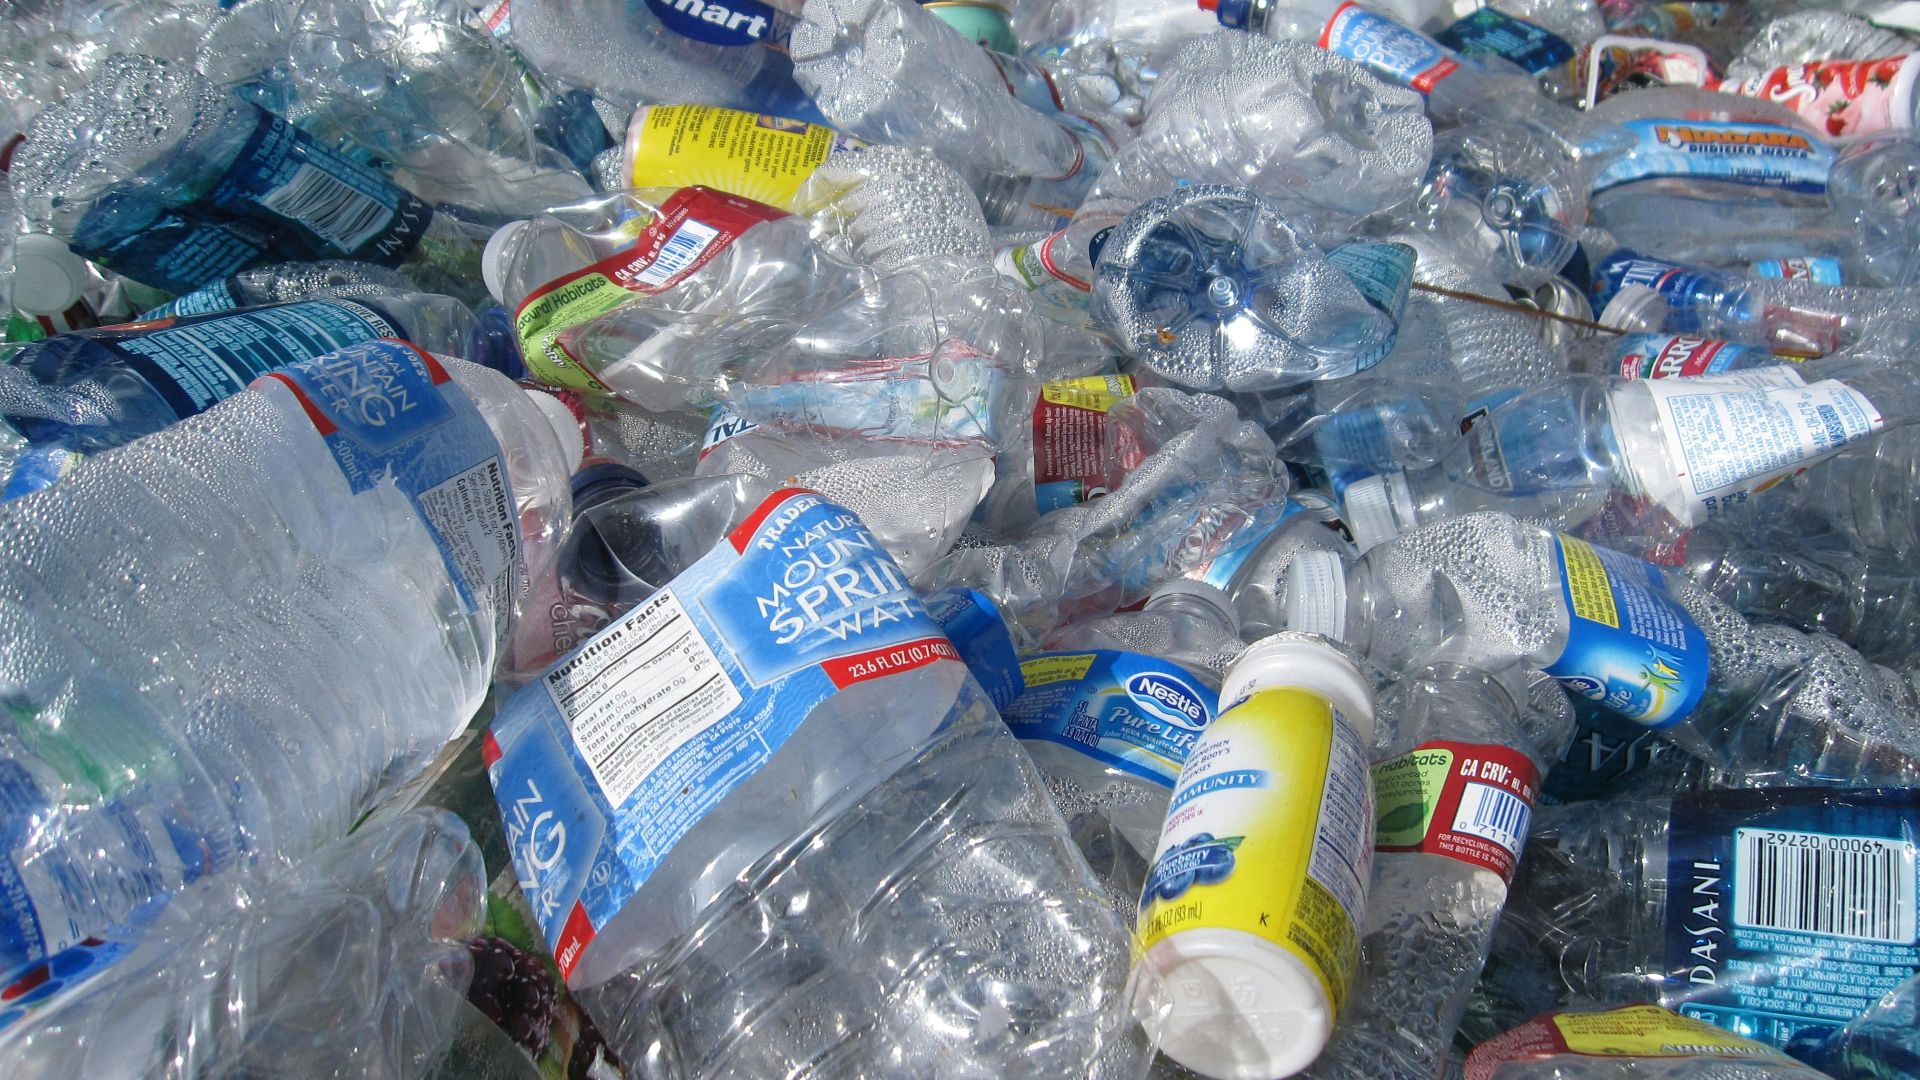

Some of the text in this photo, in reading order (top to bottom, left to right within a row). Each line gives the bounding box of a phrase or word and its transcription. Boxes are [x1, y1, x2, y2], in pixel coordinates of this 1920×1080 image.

[742, 157, 751, 173] goes
[613, 264, 633, 284] CA
[553, 274, 607, 307] Habitats
[333, 439, 362, 482] 500mL
[453, 477, 475, 515] Calories
[464, 471, 493, 537] Servings about 2
[480, 487, 496, 506] Size
[482, 461, 514, 521] Nutrition
[757, 497, 822, 551] TRADER
[549, 594, 671, 685] Nutrition Facts
[550, 609, 664, 694] Serving Size 8 fl oz (240mL)
[554, 606, 677, 700] Servings Per Container about 3
[681, 638, 701, 655] 0%
[686, 646, 706, 664] 0%
[691, 655, 712, 672] 0%
[847, 660, 878, 679] 23.6
[876, 654, 892, 670] FL
[890, 650, 910, 667] OZ
[560, 657, 629, 709] Amount Per Serving
[564, 681, 609, 719] Calories 0
[573, 688, 629, 734] Total Fat 0g
[584, 674, 687, 753] Total Carbohydrate 0g
[700, 697, 714, 709] and
[577, 694, 639, 743] Sodium 0mg
[609, 731, 647, 762] significant
[641, 717, 665, 735] source
[670, 693, 699, 716] calories
[1107, 705, 1167, 739] Pure
[588, 721, 638, 764] Protein 0g
[633, 749, 657, 770] Daily
[651, 730, 680, 753] Values
[677, 722, 692, 734] are
[690, 707, 714, 726] based
[713, 699, 726, 711] on
[708, 729, 722, 742] CA
[1120, 725, 1184, 756] AGUA PURIFICADA
[652, 725, 719, 778] SOLD EXCLUSIVELY
[693, 737, 751, 784] INFORMATION AND
[1377, 749, 1448, 774] Habitats
[614, 757, 659, 799] 2,000 calorie
[1459, 756, 1513, 786] CA CRV;
[1437, 832, 1451, 842] FOR
[1458, 820, 1468, 830] 0
[1438, 841, 1490, 860] THIS BOTTLE IS
[1735, 829, 1883, 852] 49000 02762 4
[1155, 846, 1210, 879] Blueberry
[1257, 911, 1272, 928] K
[1682, 861, 1726, 986] DASANI
[1733, 928, 1835, 947] VISIT WWW.DASANI.COM
[1816, 957, 1879, 973] THE COCA-COLA
[1832, 948, 1851, 958] AND
[1853, 950, 1888, 962] QUALITY
[1890, 954, 1918, 965] WATER
[1790, 978, 1863, 994] UNDER AUTHORITY
[1805, 968, 1895, 986] COCA-COLA COMPANY,
[1739, 995, 1851, 1016] MEMBER OF THE COCA-COLA
[1769, 986, 1807, 1001] ATLANTA,
